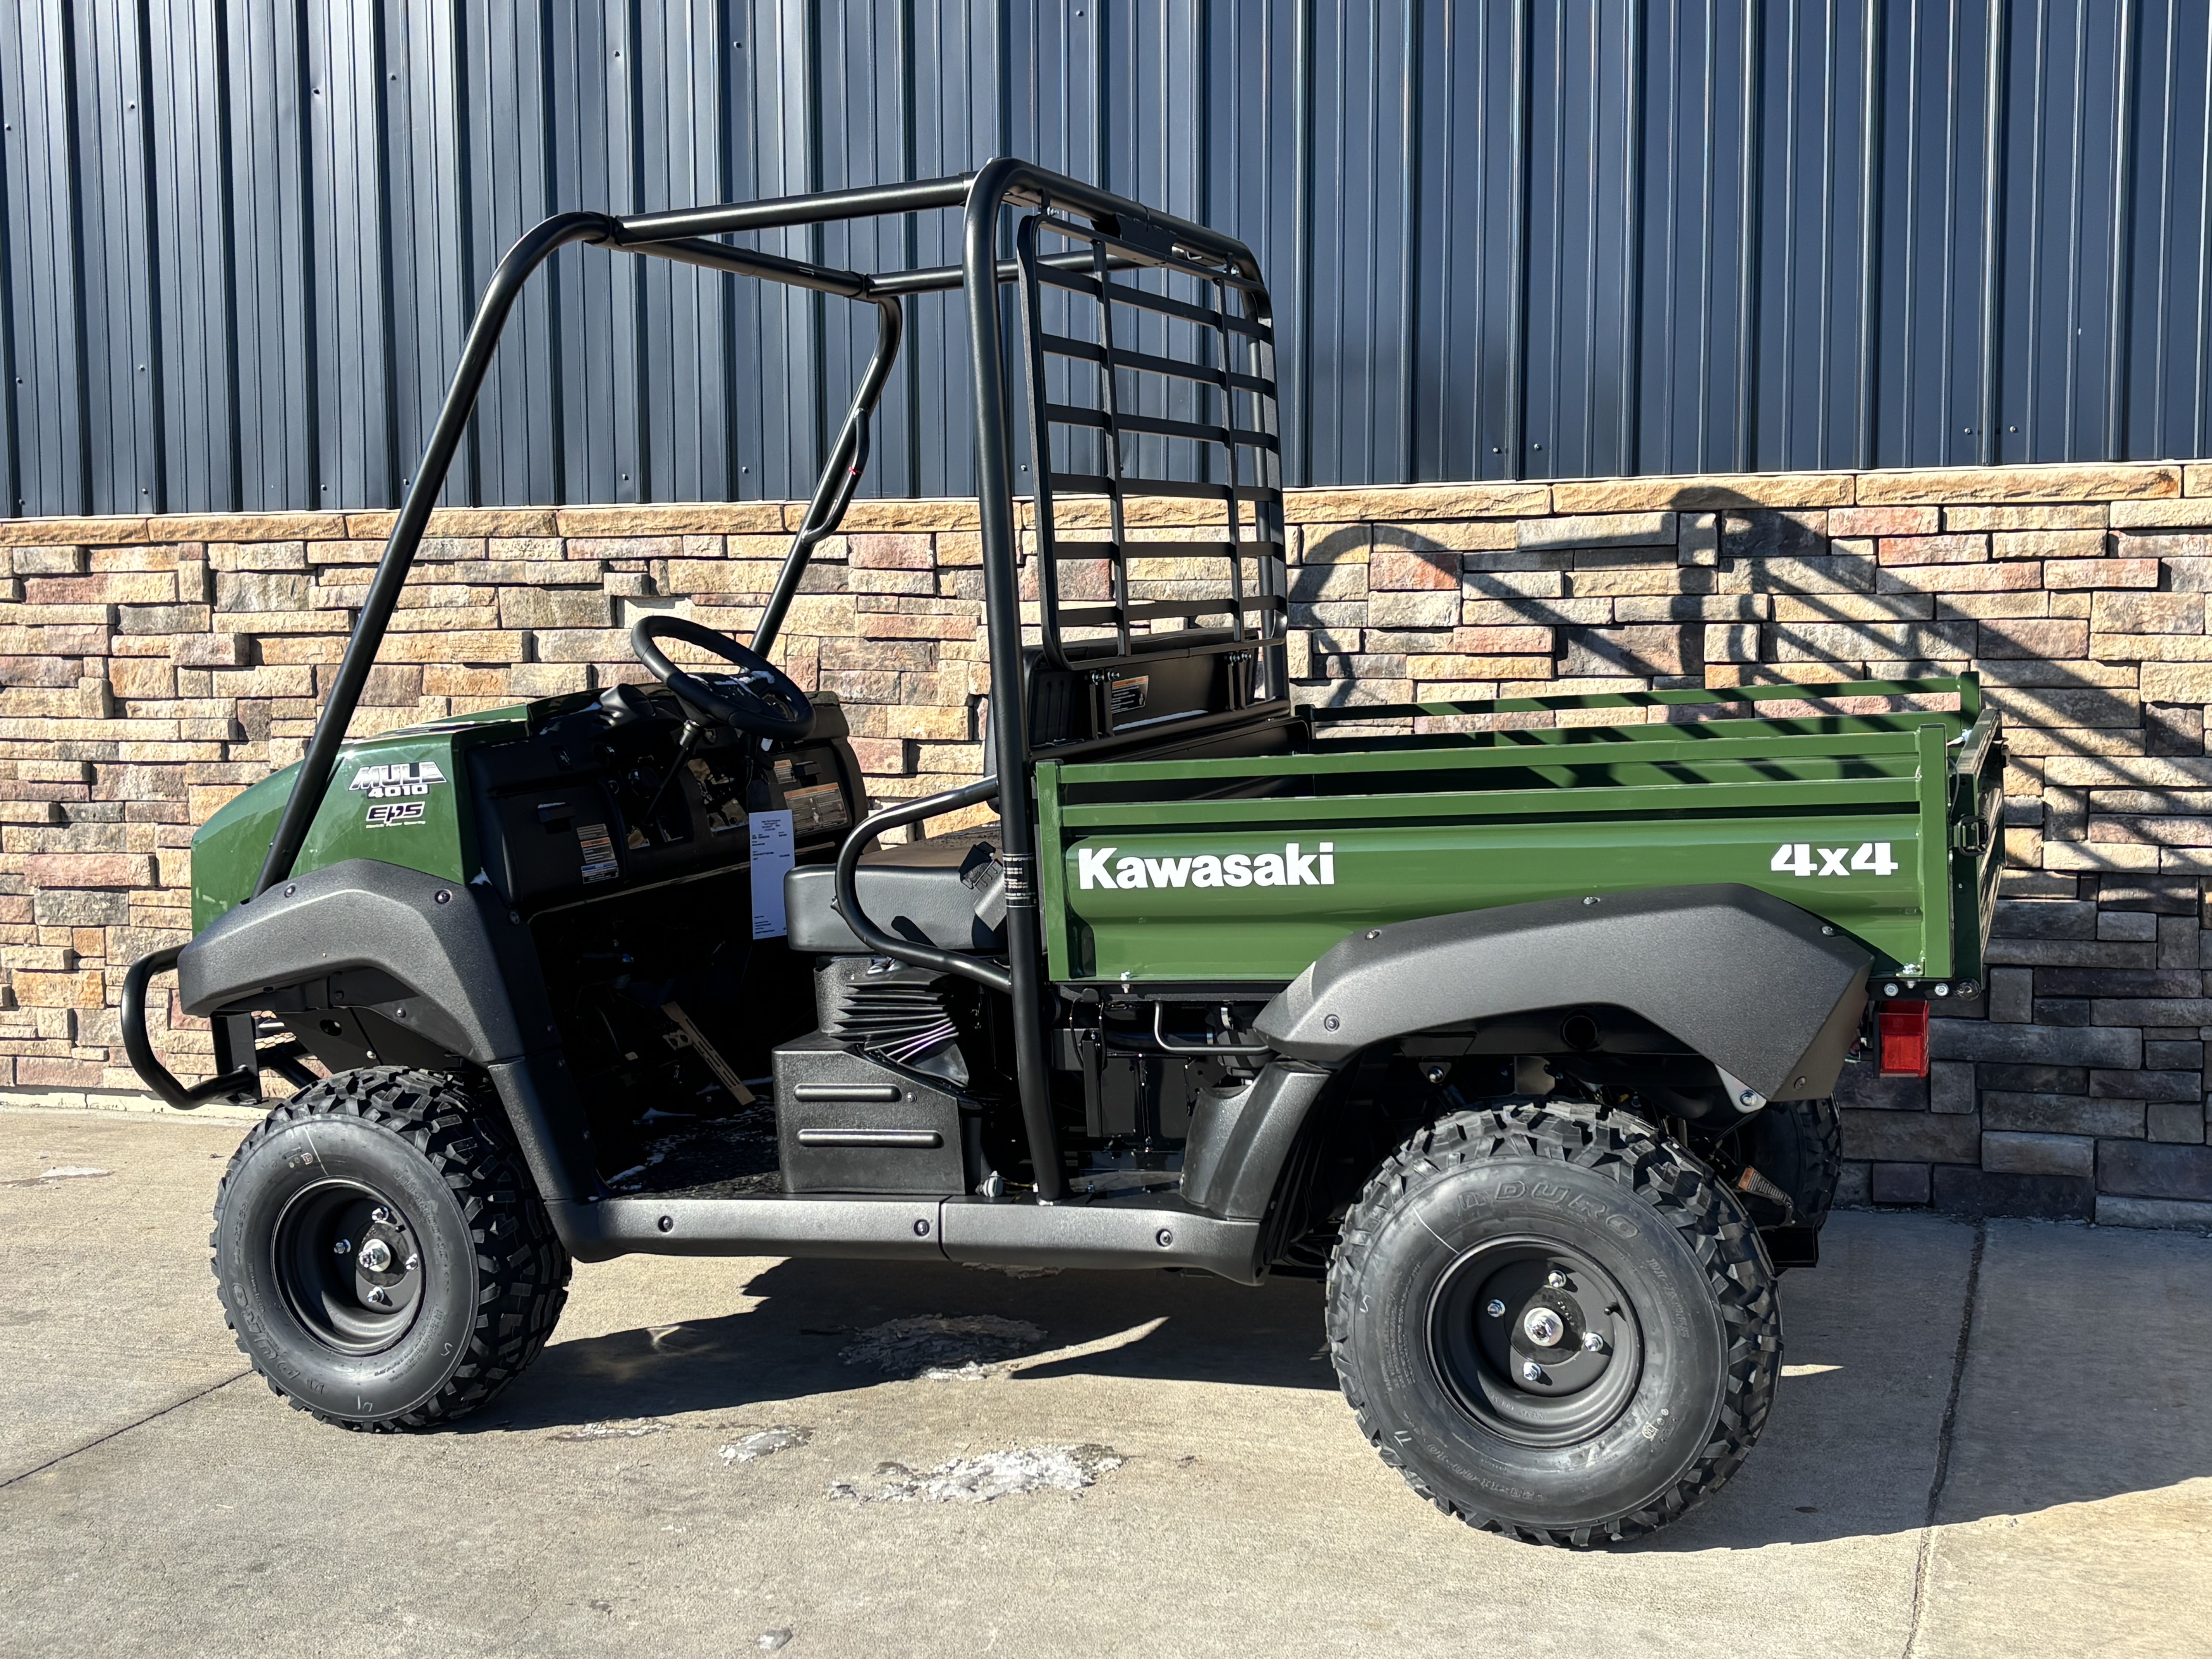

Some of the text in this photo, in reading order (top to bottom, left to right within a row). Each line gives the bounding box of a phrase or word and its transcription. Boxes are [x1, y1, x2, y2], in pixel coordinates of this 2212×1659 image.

[368, 784, 428, 798] 4010
[367, 802, 424, 823] EPS
[1078, 842, 1334, 889] Kawasaki
[1771, 843, 1898, 876] 4x4
[1495, 1180, 1641, 1238] DURO
